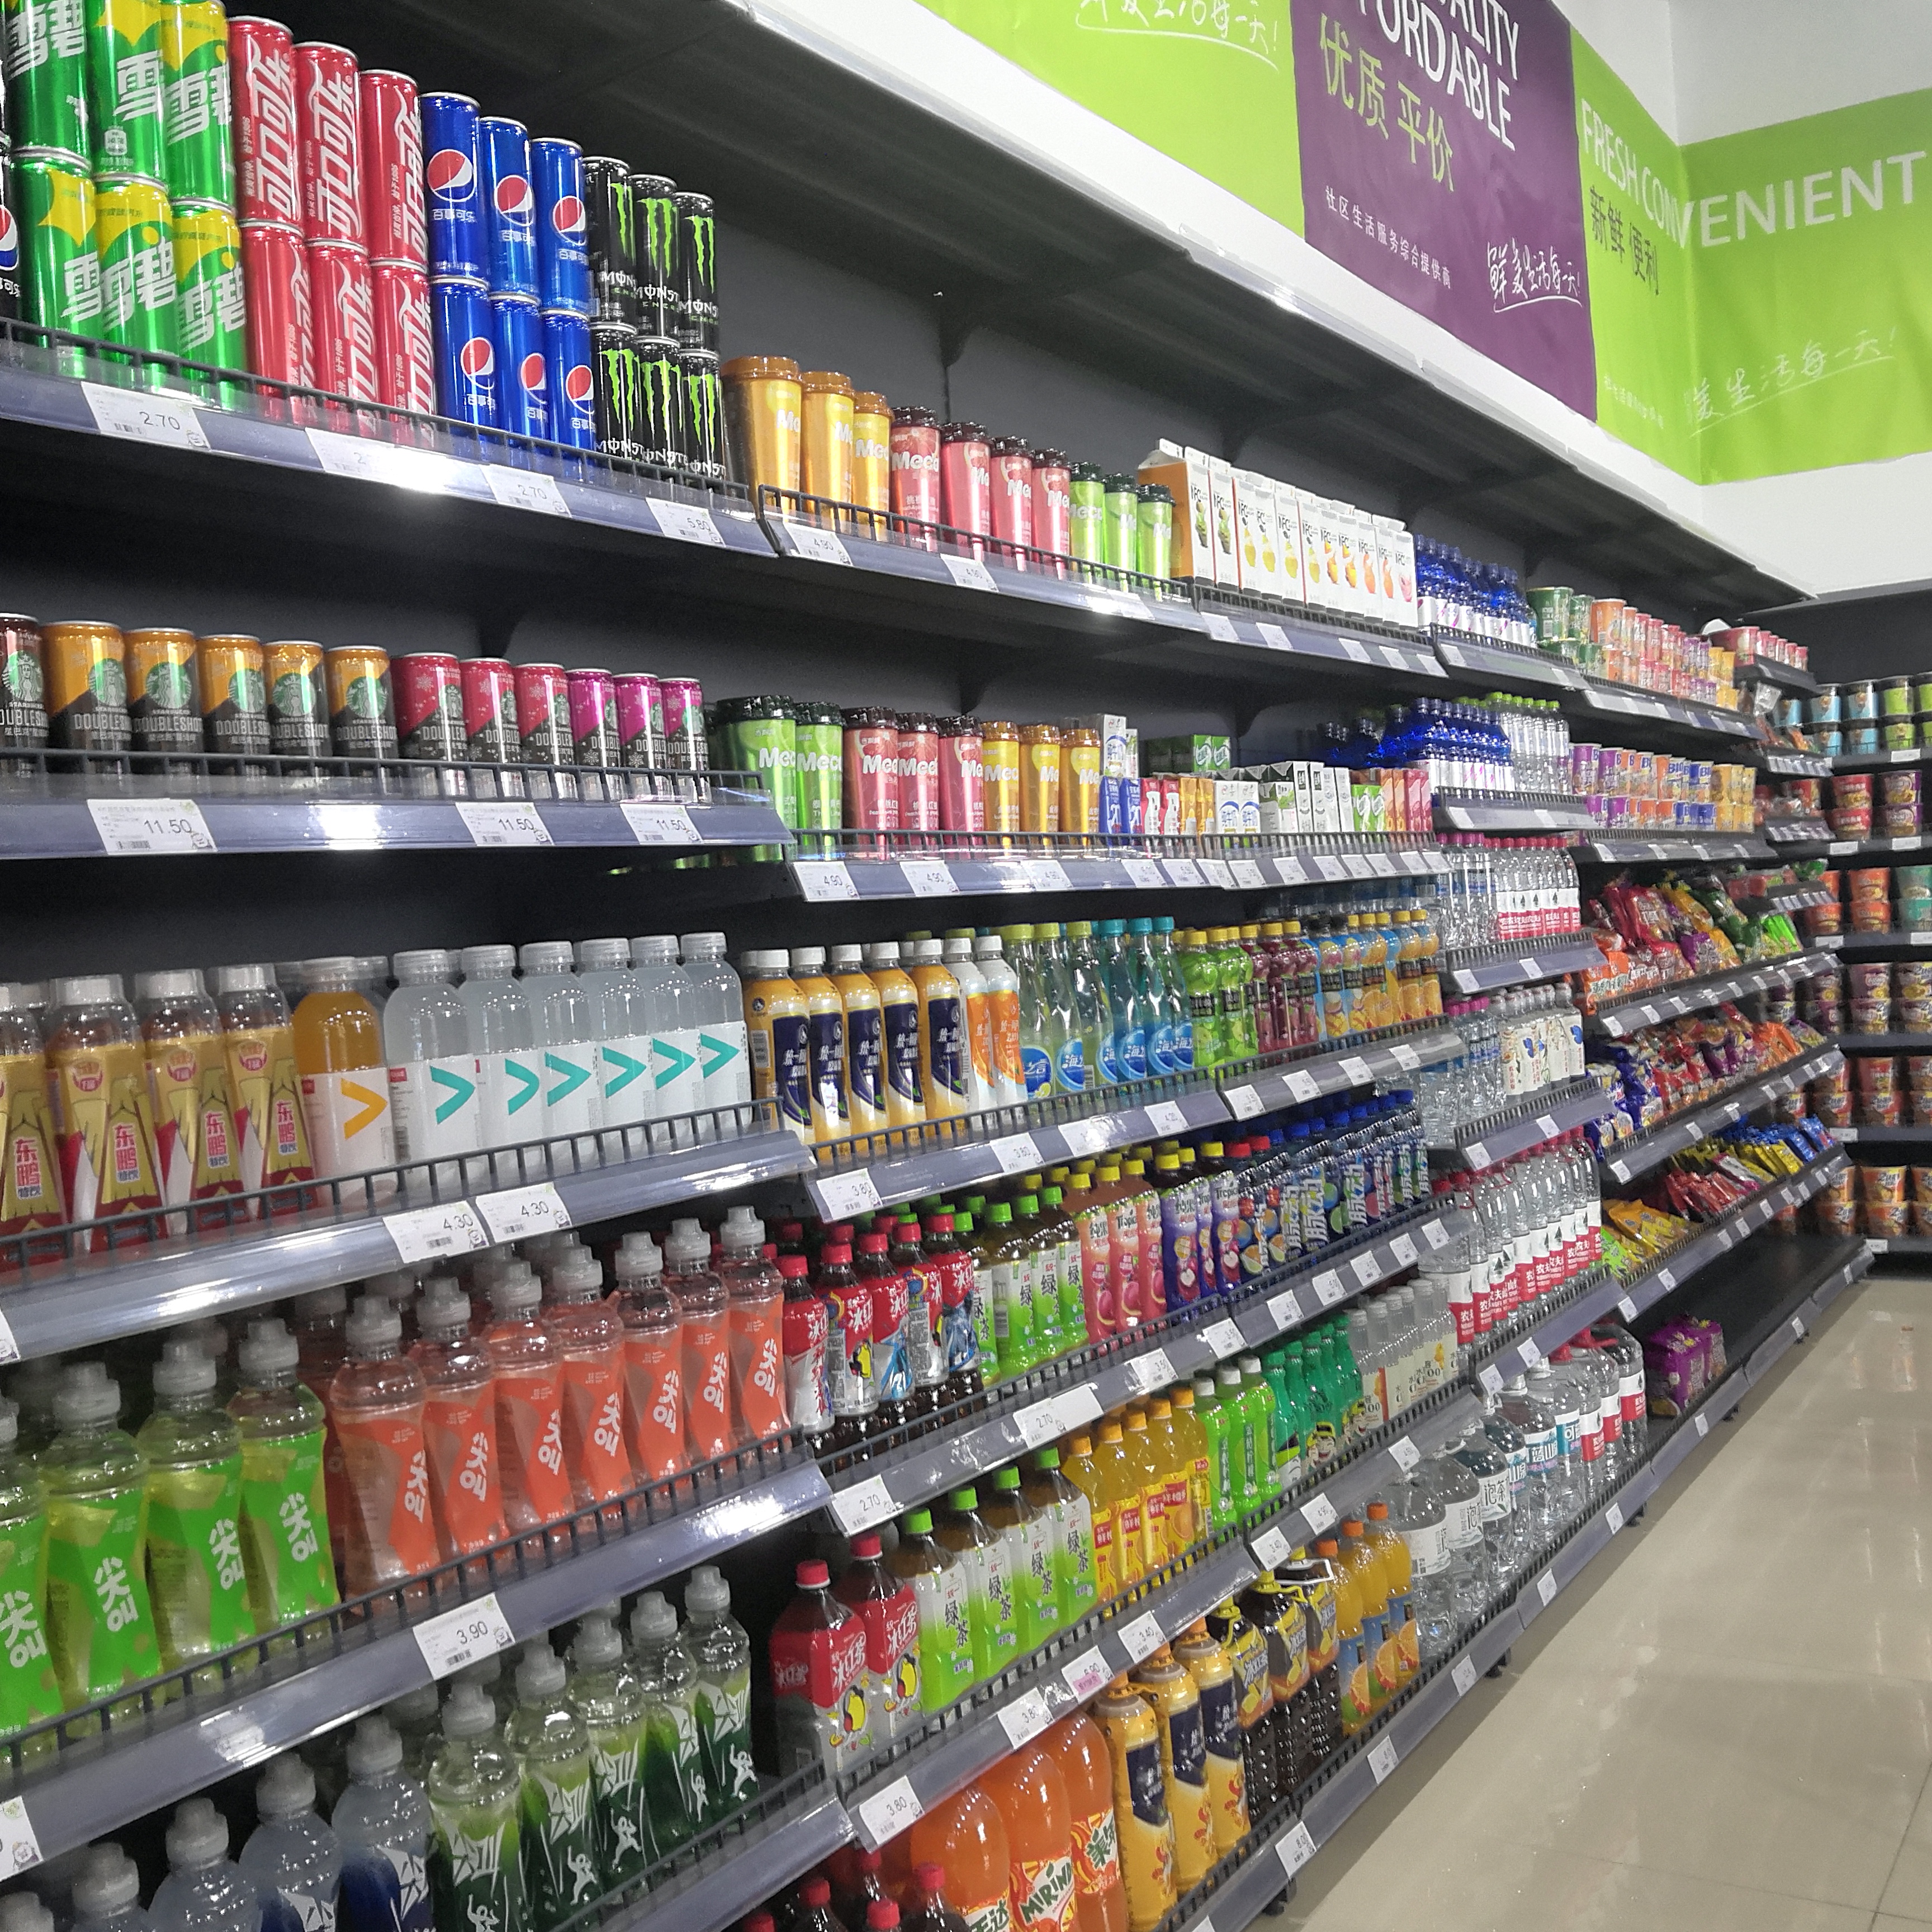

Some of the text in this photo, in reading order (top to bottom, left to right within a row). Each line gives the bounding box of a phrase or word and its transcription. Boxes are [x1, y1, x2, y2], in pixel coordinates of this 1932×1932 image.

[1441, 0, 1519, 80] ALITY
[113, 49, 166, 120] 雪
[1359, 0, 1516, 151] ORDABLE
[1320, 13, 1455, 192] 优质 平价
[246, 36, 301, 221] 可口可乐
[308, 58, 362, 239] 可口可乐
[1581, 98, 1926, 249] FRESH CONVENIENT
[1589, 184, 1659, 296] 新鲜 便利
[60, 250, 102, 323] 雪
[102, 236, 177, 333] 雪碧
[139, 410, 181, 432] 2.70
[518, 485, 547, 499] 2.70
[143, 818, 192, 835] 11.50
[498, 817, 534, 831] 11.50
[656, 818, 686, 831] 11.50
[823, 875, 843, 887] 4.90
[520, 1200, 550, 1218] 4.30
[1216, 1186, 1239, 1200] Tropic
[442, 1213, 474, 1231] 4.30
[1116, 1215, 1137, 1229] Tropic
[848, 1295, 873, 1334] 冰红
[859, 1493, 880, 1511] 2.70
[280, 1492, 319, 1561] 尖叫
[1031, 1551, 1053, 1596] 绿茶
[1067, 1530, 1089, 1574] 绿茶
[988, 1574, 1012, 1622] 绿茶
[456, 1620, 489, 1646] 3.90
[944, 1599, 968, 1648] 绿茶
[886, 1796, 907, 1817] 3.80
